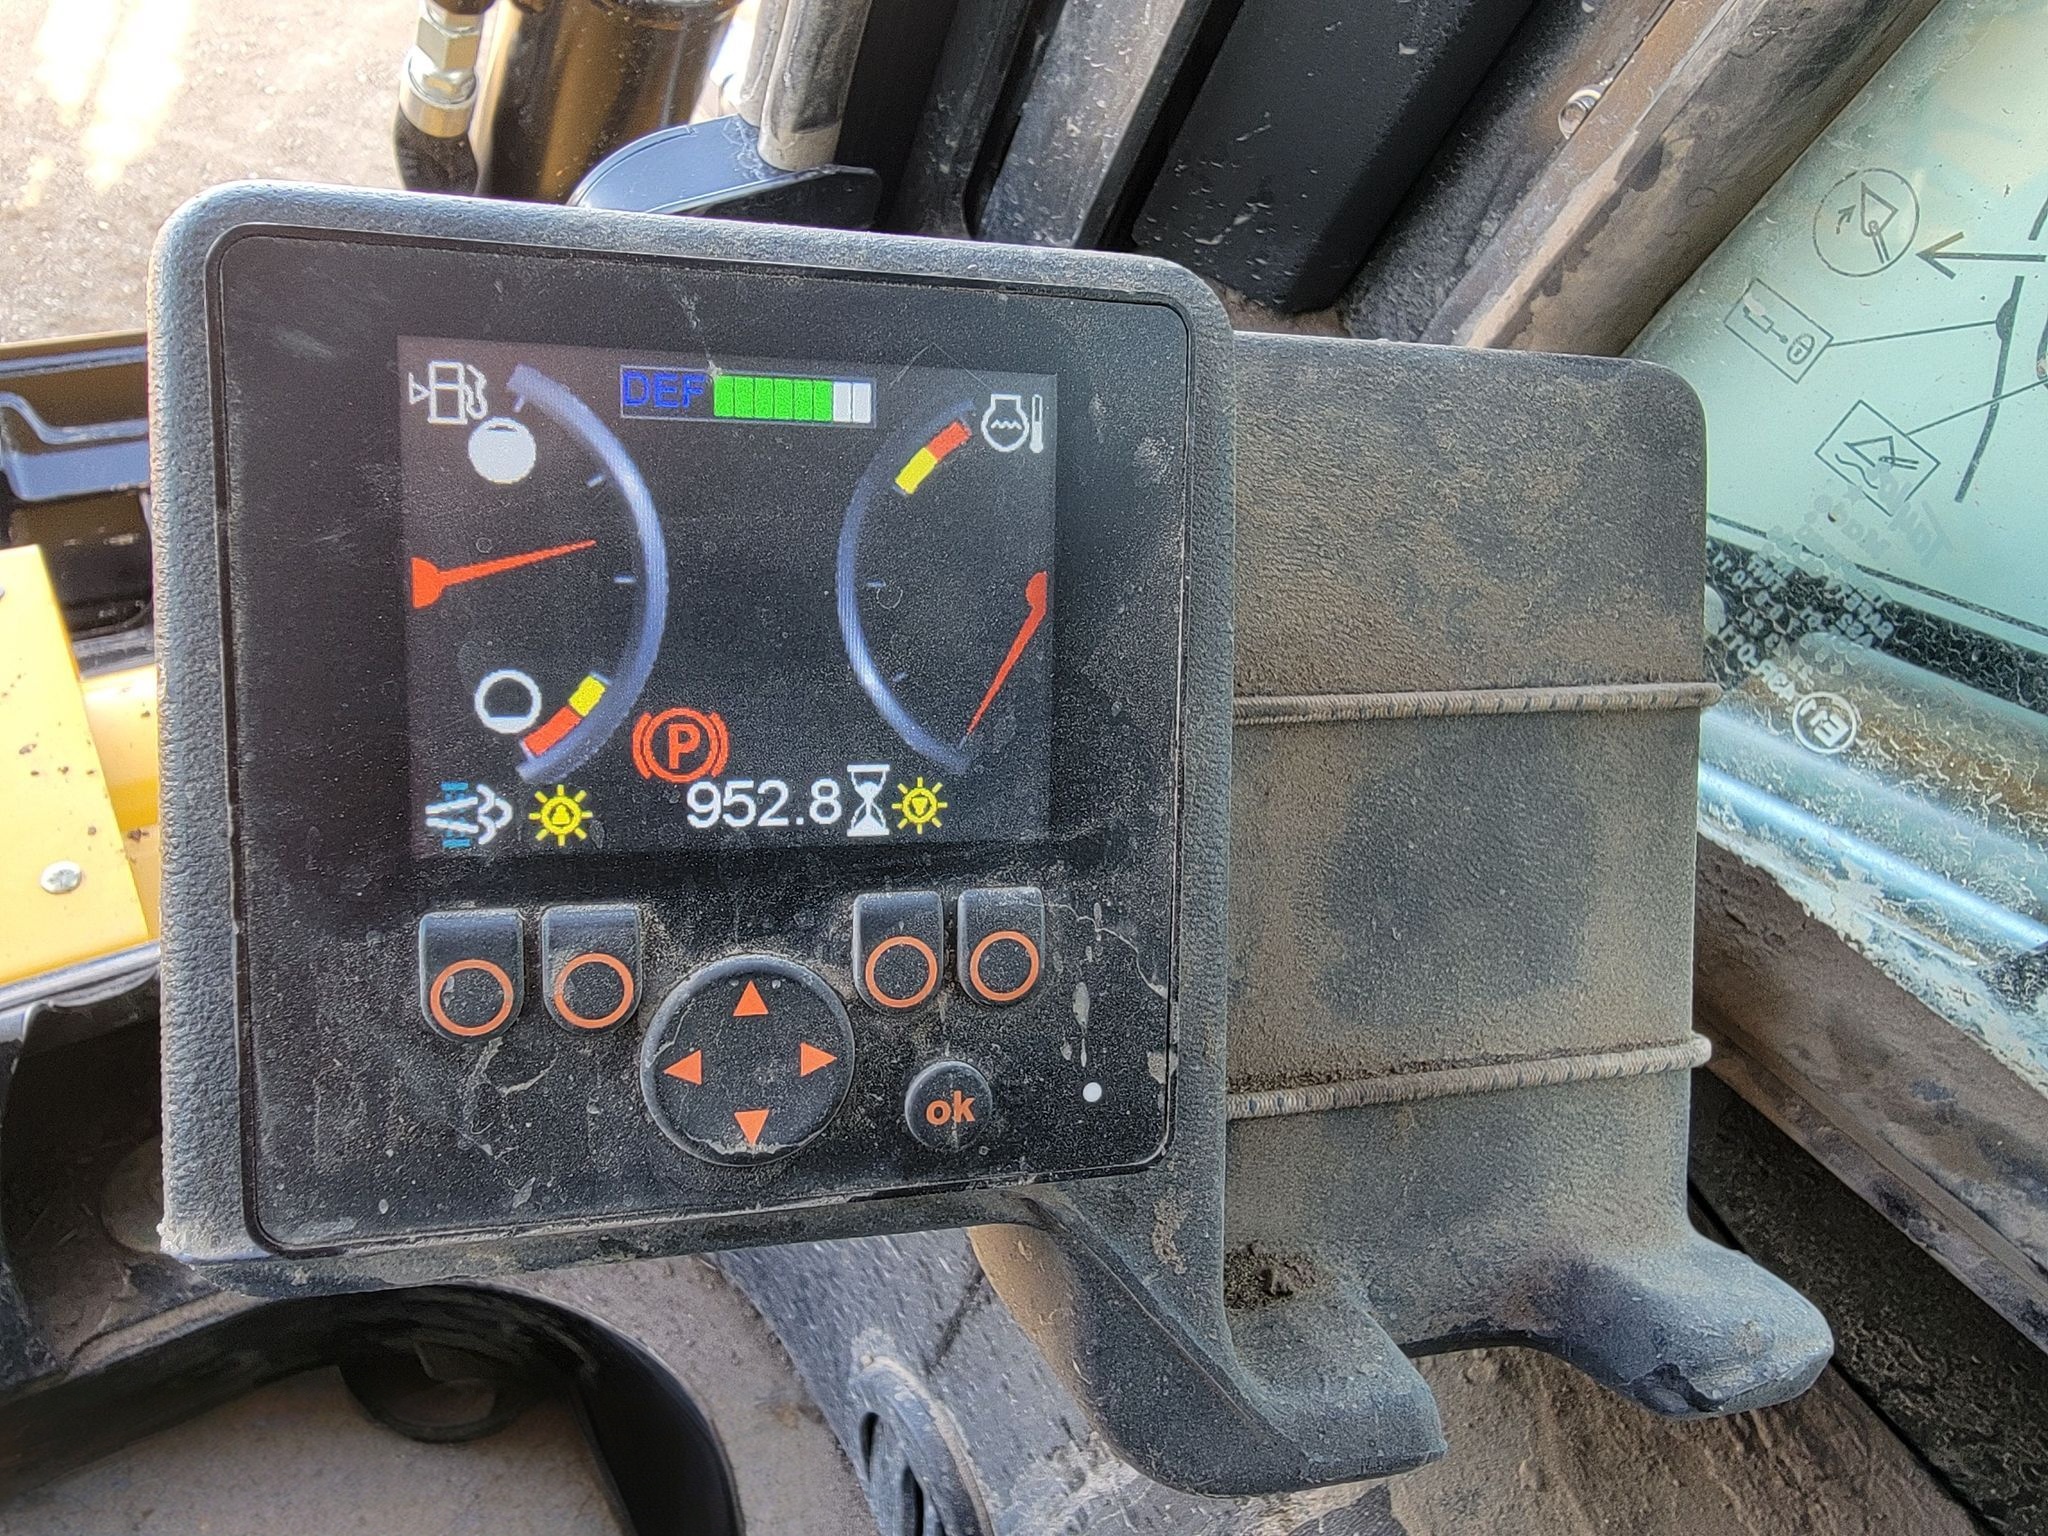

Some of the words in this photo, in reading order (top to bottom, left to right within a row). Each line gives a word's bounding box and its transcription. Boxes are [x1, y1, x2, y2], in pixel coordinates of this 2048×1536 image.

[623, 371, 704, 408] DEF
[687, 778, 842, 828] 952.8
[926, 1090, 976, 1125] ok
